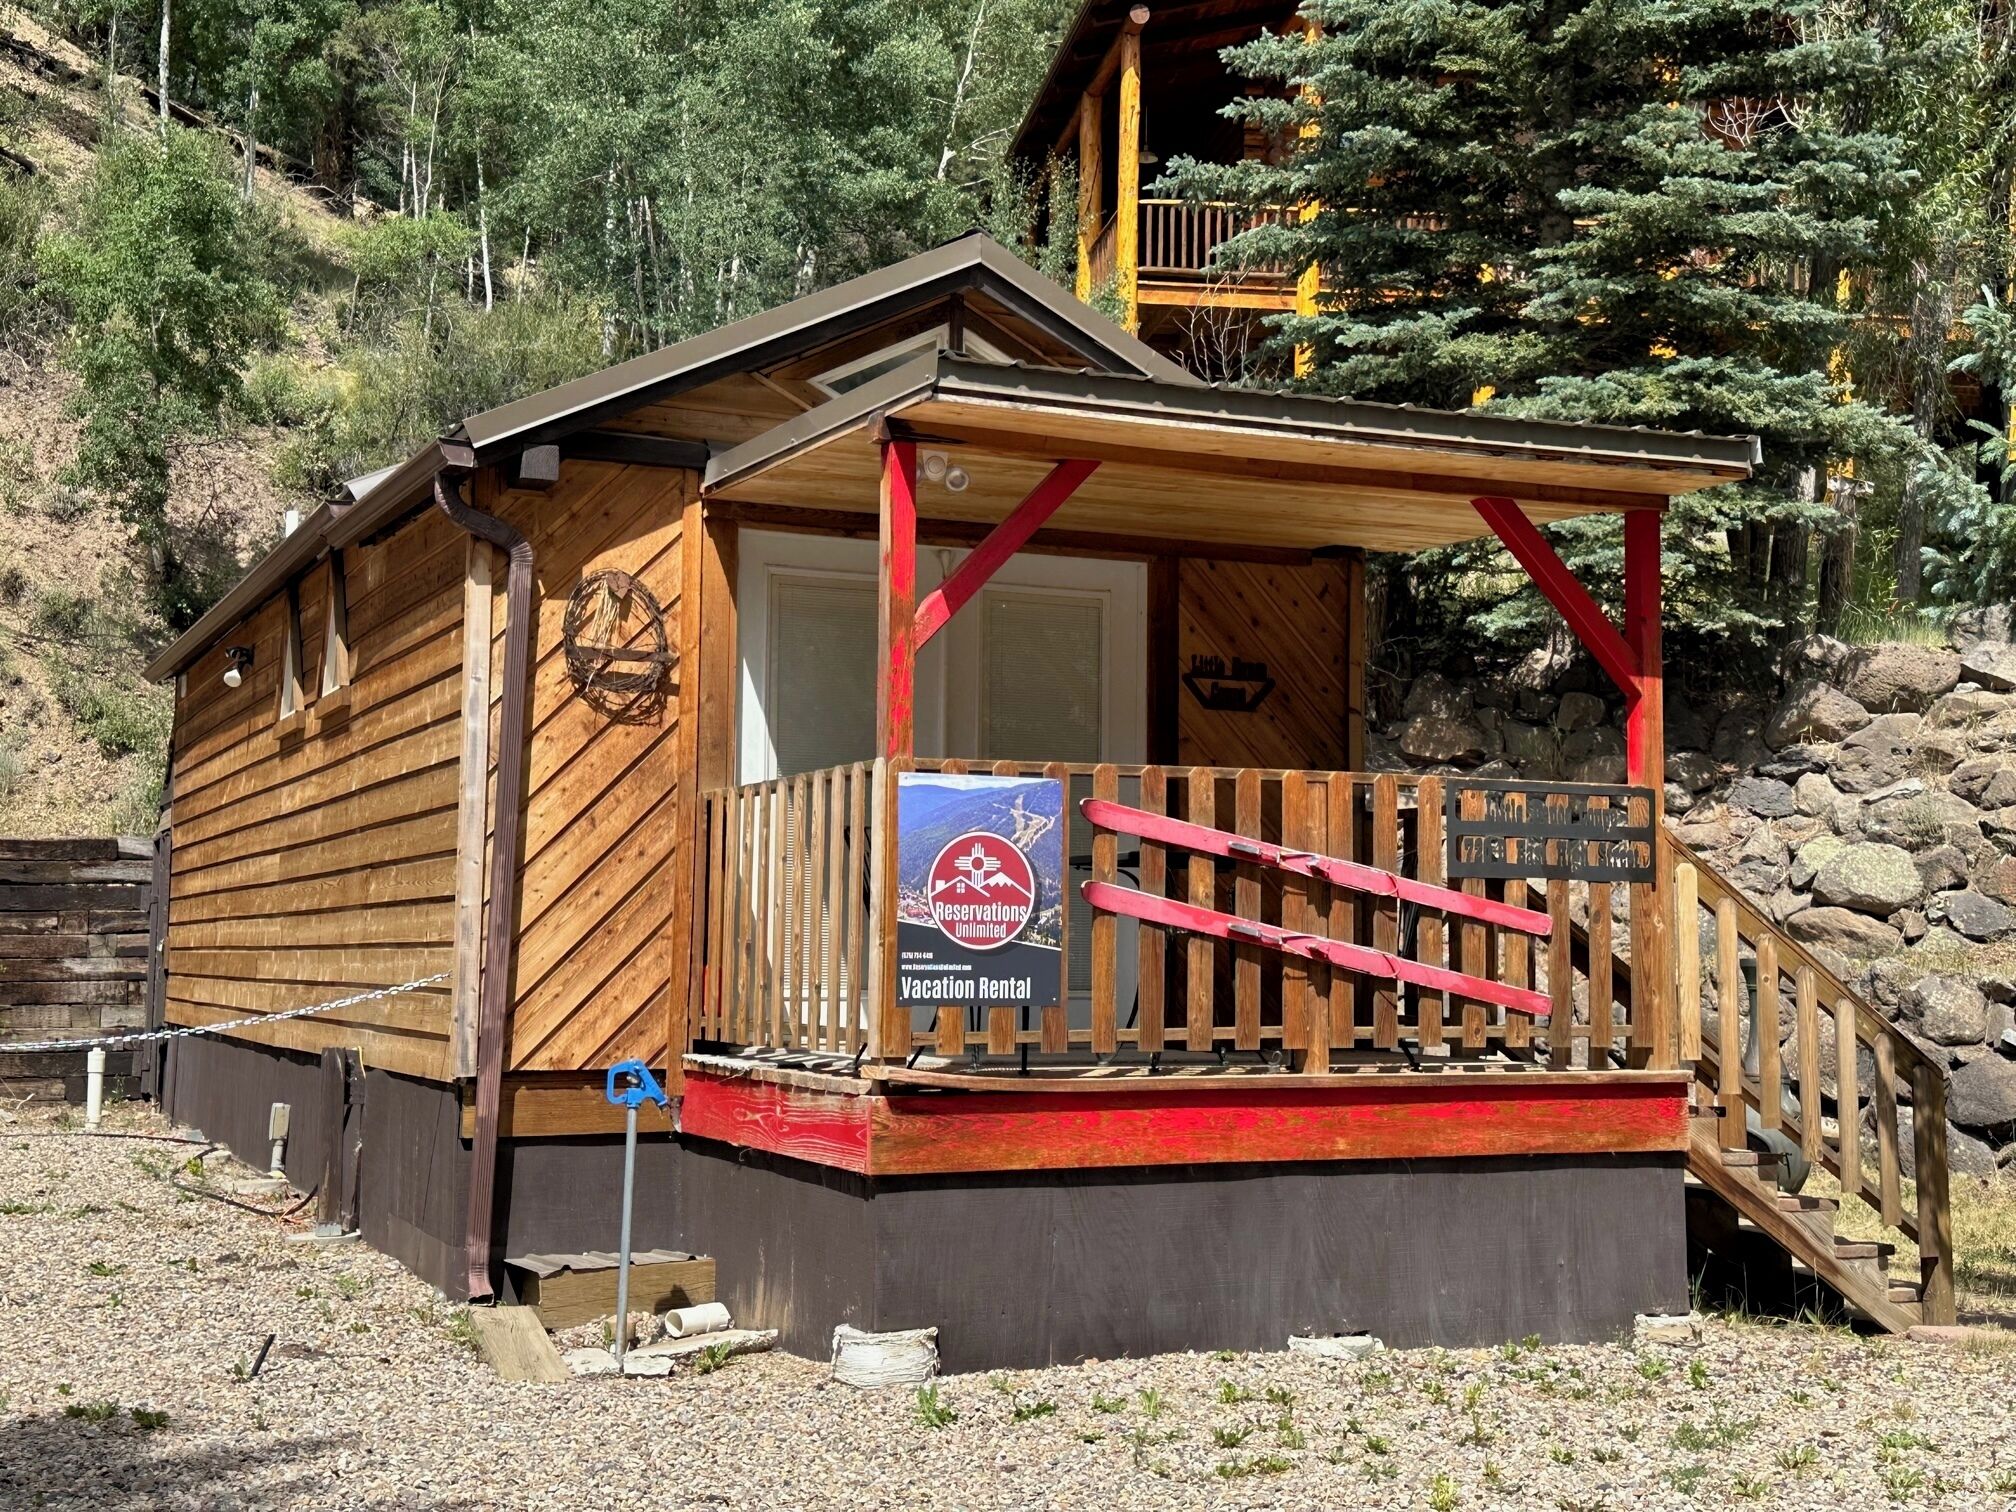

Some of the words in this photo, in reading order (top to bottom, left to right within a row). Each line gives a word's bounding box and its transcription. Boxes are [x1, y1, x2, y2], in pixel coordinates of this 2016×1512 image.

[936, 901, 1027, 921] Reservations
[955, 922, 1007, 938] Unlimited
[901, 976, 975, 999] Vacation
[979, 977, 1031, 999] Rental
